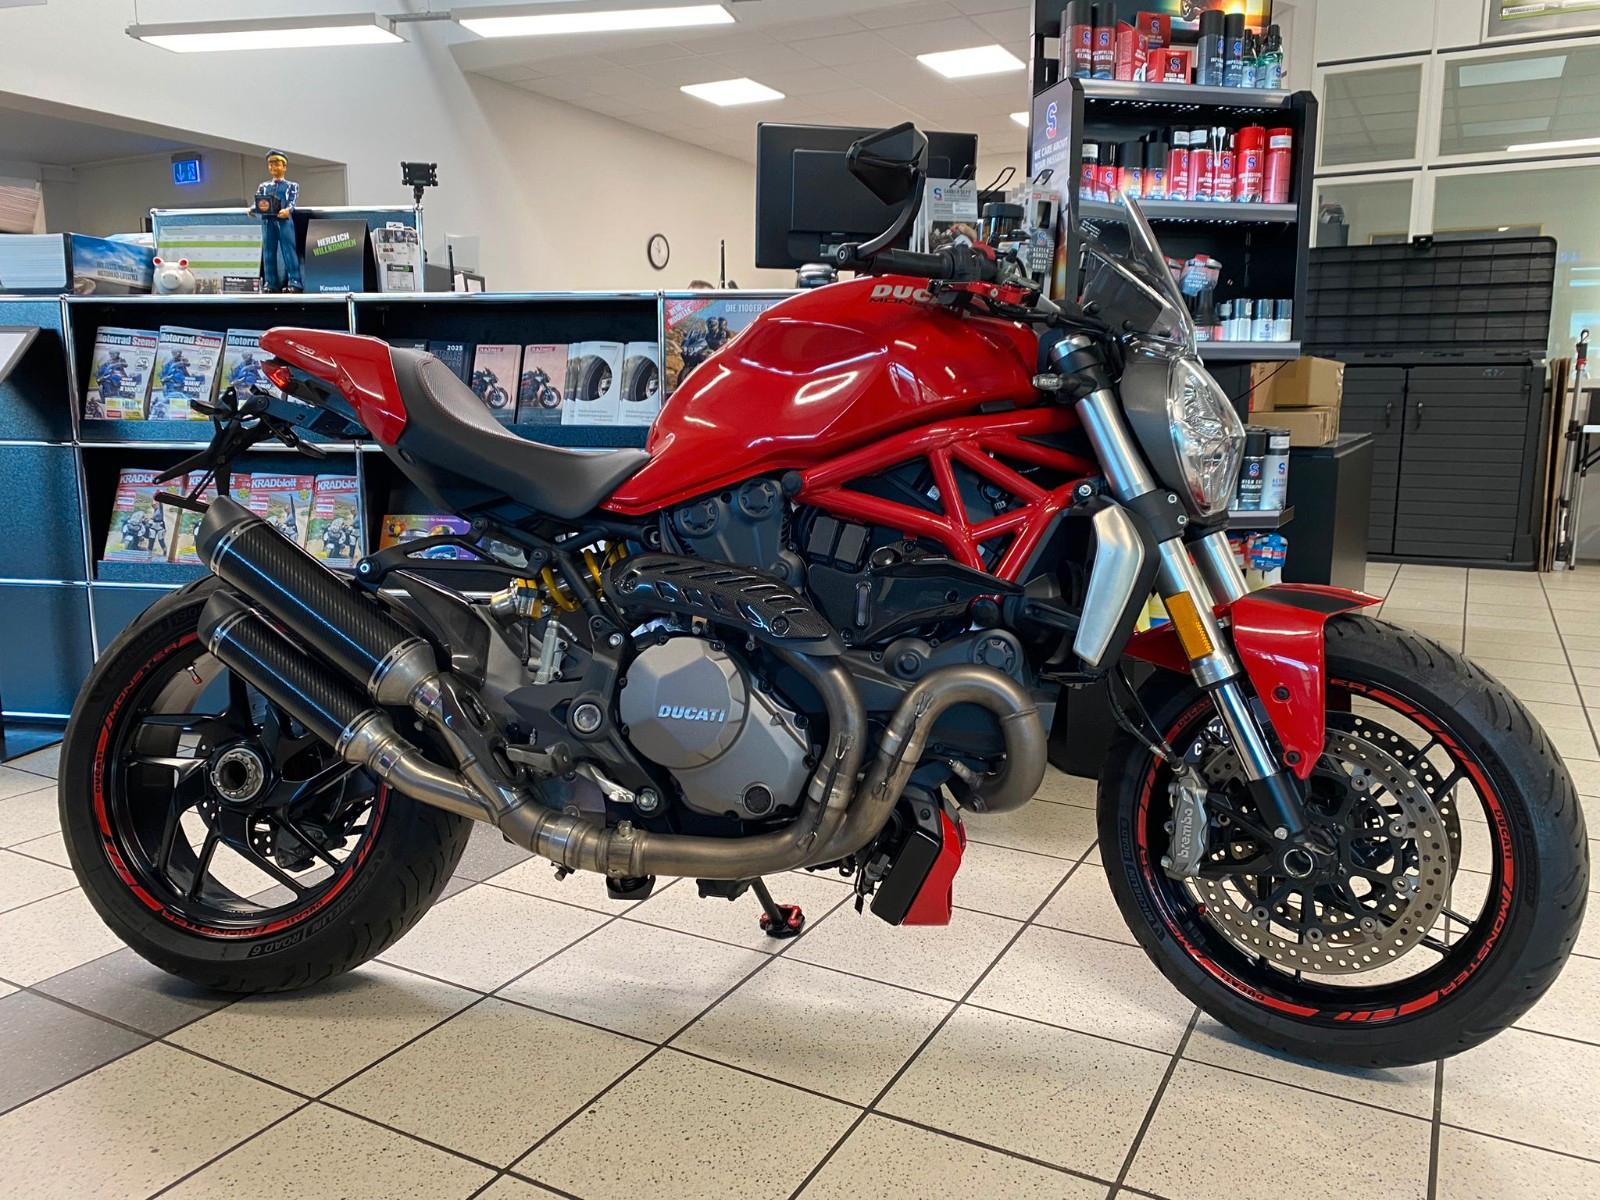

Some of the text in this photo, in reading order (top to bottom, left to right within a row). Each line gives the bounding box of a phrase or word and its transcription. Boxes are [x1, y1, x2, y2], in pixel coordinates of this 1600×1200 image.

[312, 239, 357, 256] WILLKOMMEN
[317, 232, 350, 247] HERZLICH
[871, 285, 933, 302] DUC
[725, 304, 737, 313] DIE
[228, 335, 260, 347] Motorra
[120, 474, 155, 484] KRADbl
[251, 478, 297, 489] KRADblatt
[317, 480, 358, 490] KRADbla
[657, 704, 727, 723] DUCATI
[1177, 807, 1194, 859] brembo
[1494, 808, 1513, 860] DUCATI
[1440, 896, 1512, 996] MONSTER
